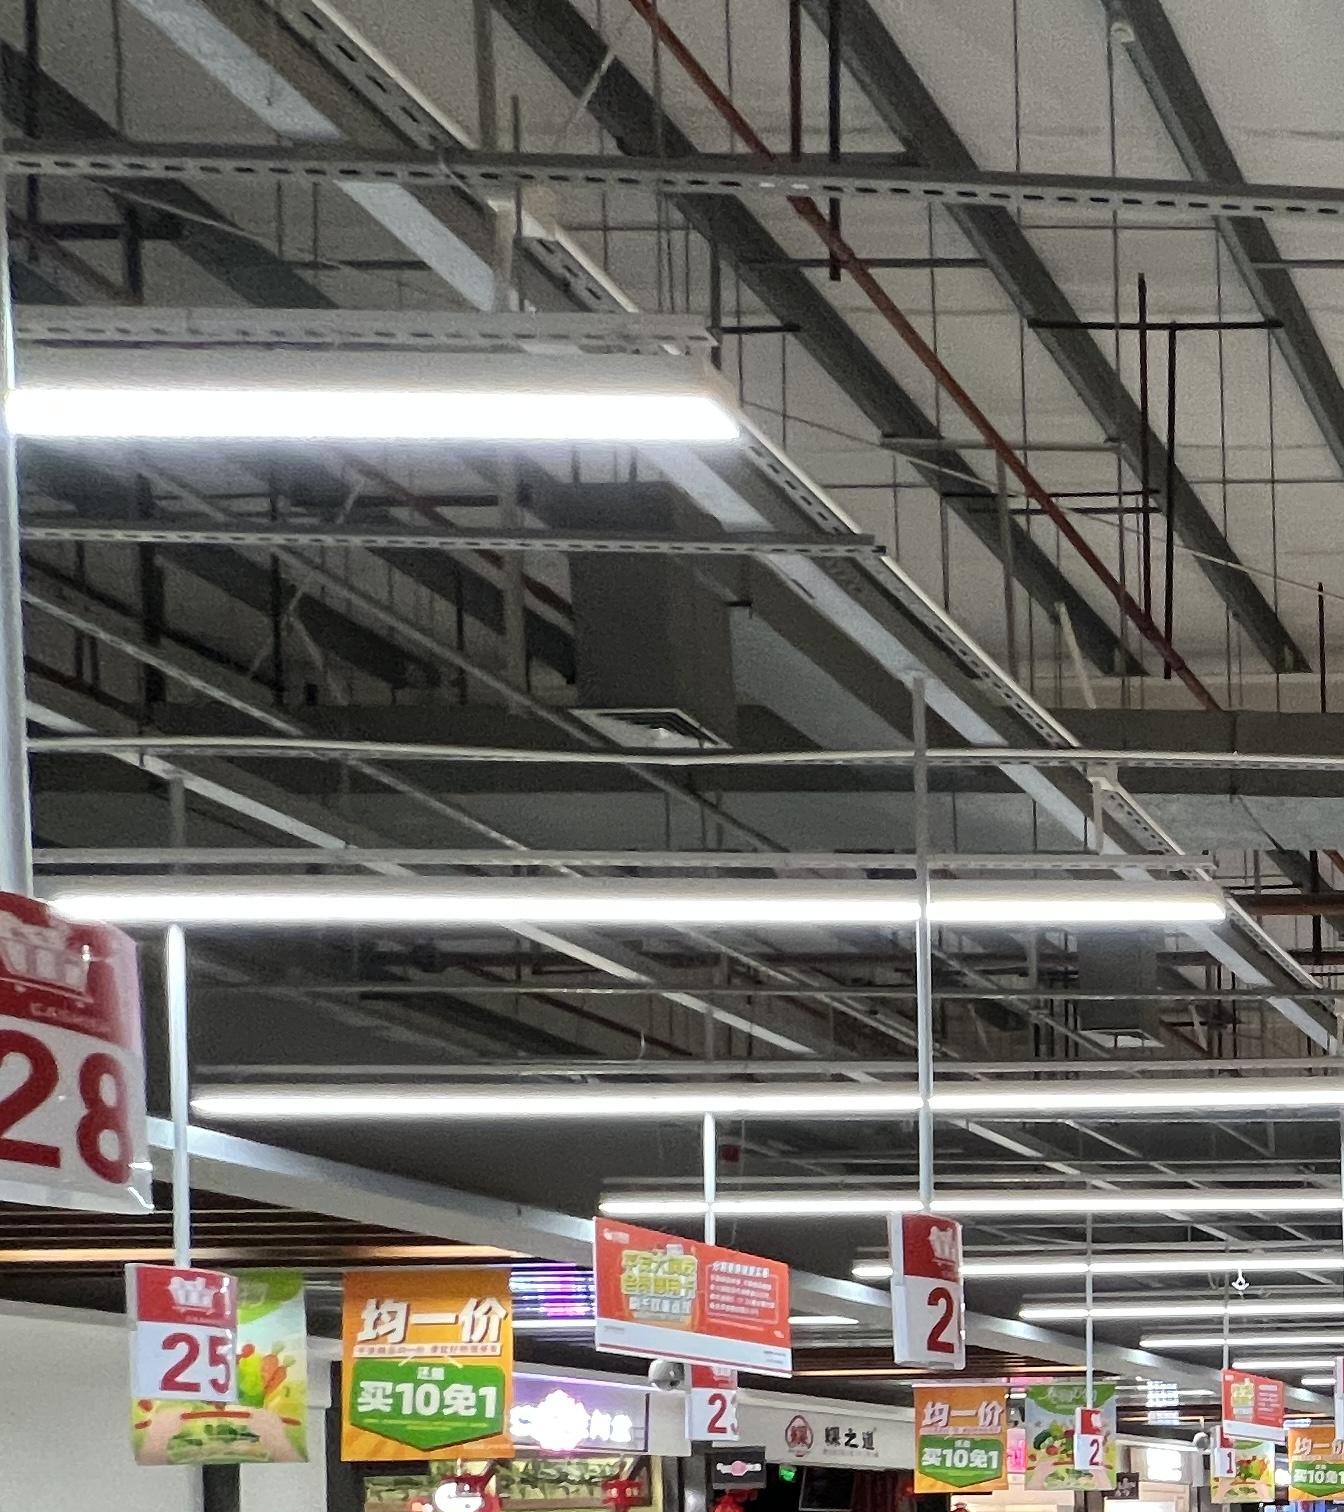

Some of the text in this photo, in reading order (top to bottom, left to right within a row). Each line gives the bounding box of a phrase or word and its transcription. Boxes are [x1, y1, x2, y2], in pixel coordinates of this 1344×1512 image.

[0, 1029, 130, 1185] 28
[357, 1298, 508, 1344] 均一价
[160, 1332, 233, 1395] 25
[357, 1381, 497, 1418] 买10免1
[708, 1393, 737, 1433] 2
[923, 1401, 1003, 1428] 均一价
[922, 1448, 998, 1470] 买10免1
[1089, 1438, 1100, 1466] 2
